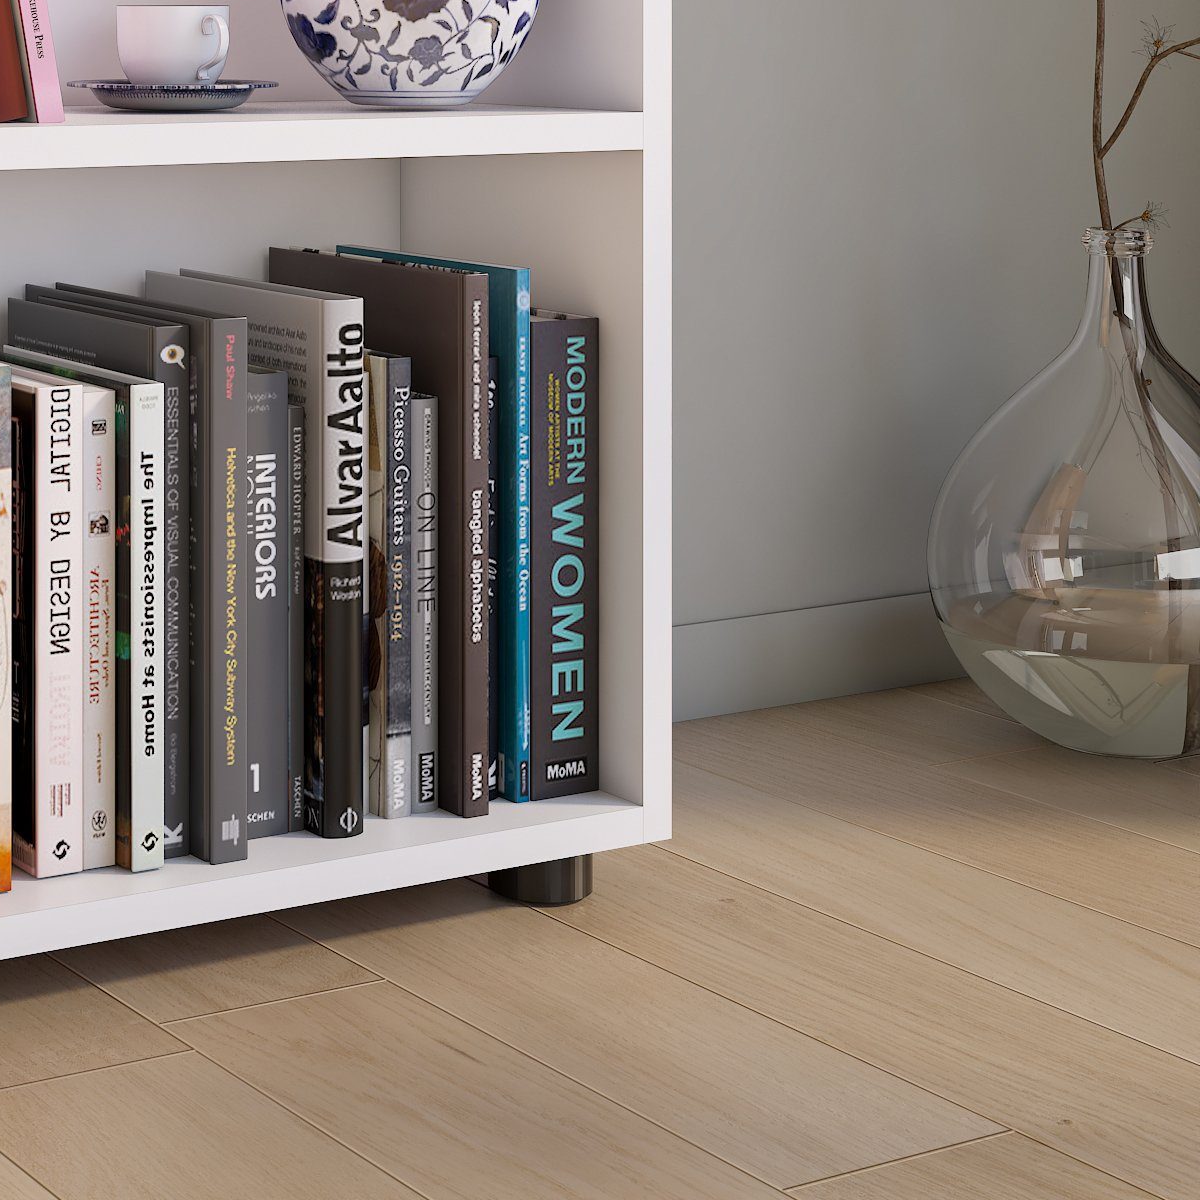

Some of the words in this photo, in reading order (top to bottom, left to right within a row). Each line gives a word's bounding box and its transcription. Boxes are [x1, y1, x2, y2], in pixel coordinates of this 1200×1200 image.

[225, 335, 235, 362] Paul
[473, 326, 482, 361] ferrari
[225, 365, 235, 400] Shaw
[327, 322, 363, 434] Aalto
[473, 363, 482, 383] and
[473, 384, 482, 410] mira
[566, 336, 586, 484] MODERN
[167, 386, 179, 485] ESSENTIALS
[392, 386, 410, 461] Picasso
[473, 411, 482, 460] schendel
[519, 432, 529, 455] Art
[293, 426, 302, 481] EDWARD
[167, 488, 179, 511] OF
[225, 447, 237, 508] Helvetica
[327, 441, 363, 548] Alvar
[519, 459, 529, 502] Forms
[225, 512, 237, 537] and
[255, 453, 277, 600] INTERIORS
[293, 484, 302, 535] HOPPER
[392, 464, 410, 546] Guitars
[417, 492, 436, 532] ON
[468, 490, 483, 555] tangled
[519, 505, 529, 540] from
[167, 515, 179, 574] VISUAL
[225, 539, 237, 561] the
[519, 542, 529, 566] the
[225, 563, 237, 594] New
[417, 548, 436, 614] LINE
[470, 559, 483, 643] alphabets
[519, 569, 529, 612] Ocean
[225, 596, 237, 628] York
[551, 493, 585, 742] WOMEN
[167, 577, 179, 720] COMMUNICATION
[223, 630, 237, 656] City
[223, 659, 237, 713] Subway
[223, 715, 237, 766] System
[250, 763, 260, 793] 1
[392, 758, 404, 810] MoMA
[421, 754, 434, 801] MoMA
[471, 753, 483, 801] MoMA
[547, 759, 585, 780] MoMA
[247, 810, 275, 823] SCHEN
[294, 776, 302, 818] TASCHEN
